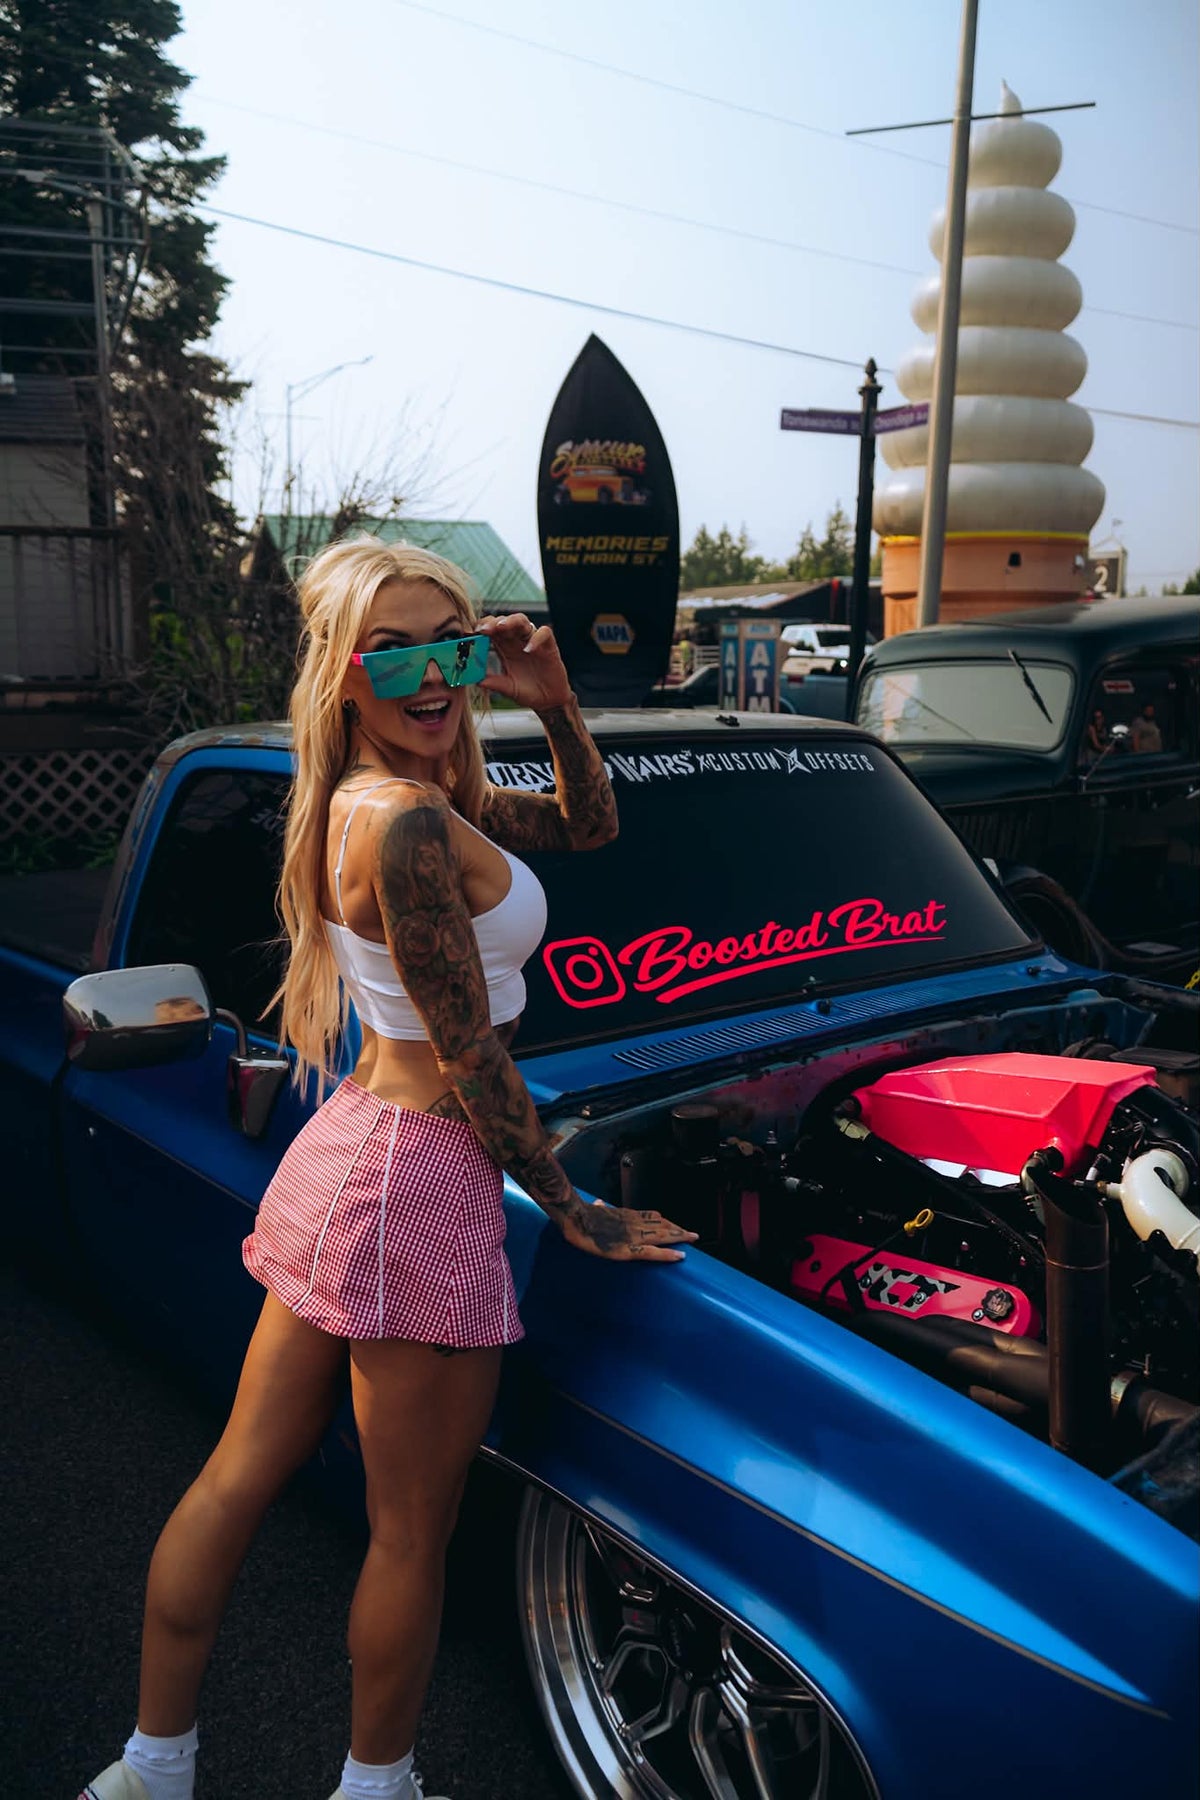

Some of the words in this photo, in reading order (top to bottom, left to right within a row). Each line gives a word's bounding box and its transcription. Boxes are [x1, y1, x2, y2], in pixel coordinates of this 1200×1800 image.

[546, 536, 669, 551] MEMORIES
[556, 554, 578, 565] ON
[583, 553, 627, 565] MAIN
[596, 626, 630, 642] NAPA
[804, 752, 875, 772] OFFSETS
[617, 911, 829, 993] Boosted
[827, 897, 947, 945] Brat
